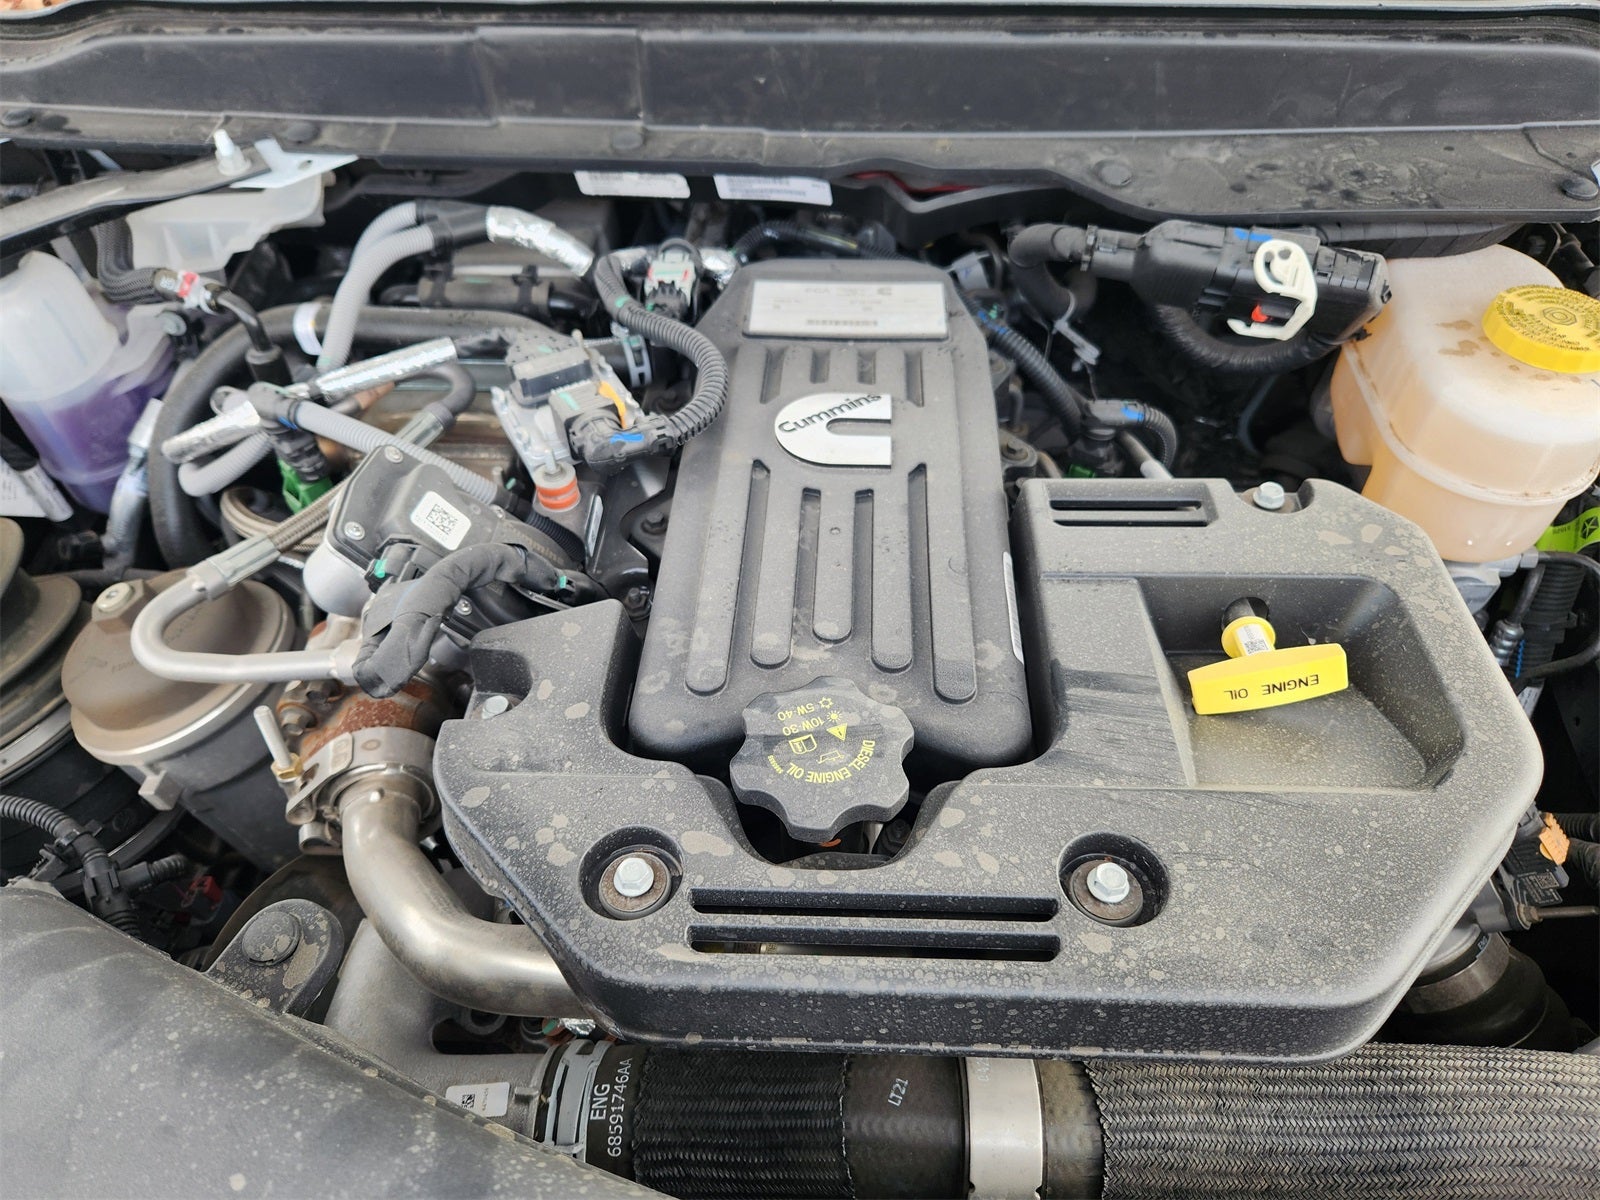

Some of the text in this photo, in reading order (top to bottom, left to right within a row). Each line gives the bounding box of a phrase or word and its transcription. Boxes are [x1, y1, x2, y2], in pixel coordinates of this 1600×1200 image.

[777, 393, 882, 433] Cummins
[1223, 673, 1320, 700] ENGINE OIL
[777, 703, 815, 721] 5W-40
[782, 716, 825, 737] 10W-30
[848, 739, 876, 772] DIESEL
[786, 761, 804, 780] OIL
[805, 767, 852, 784] ENGINE
[589, 1083, 610, 1121] ENG
[607, 1057, 633, 1158] 68591746AA
